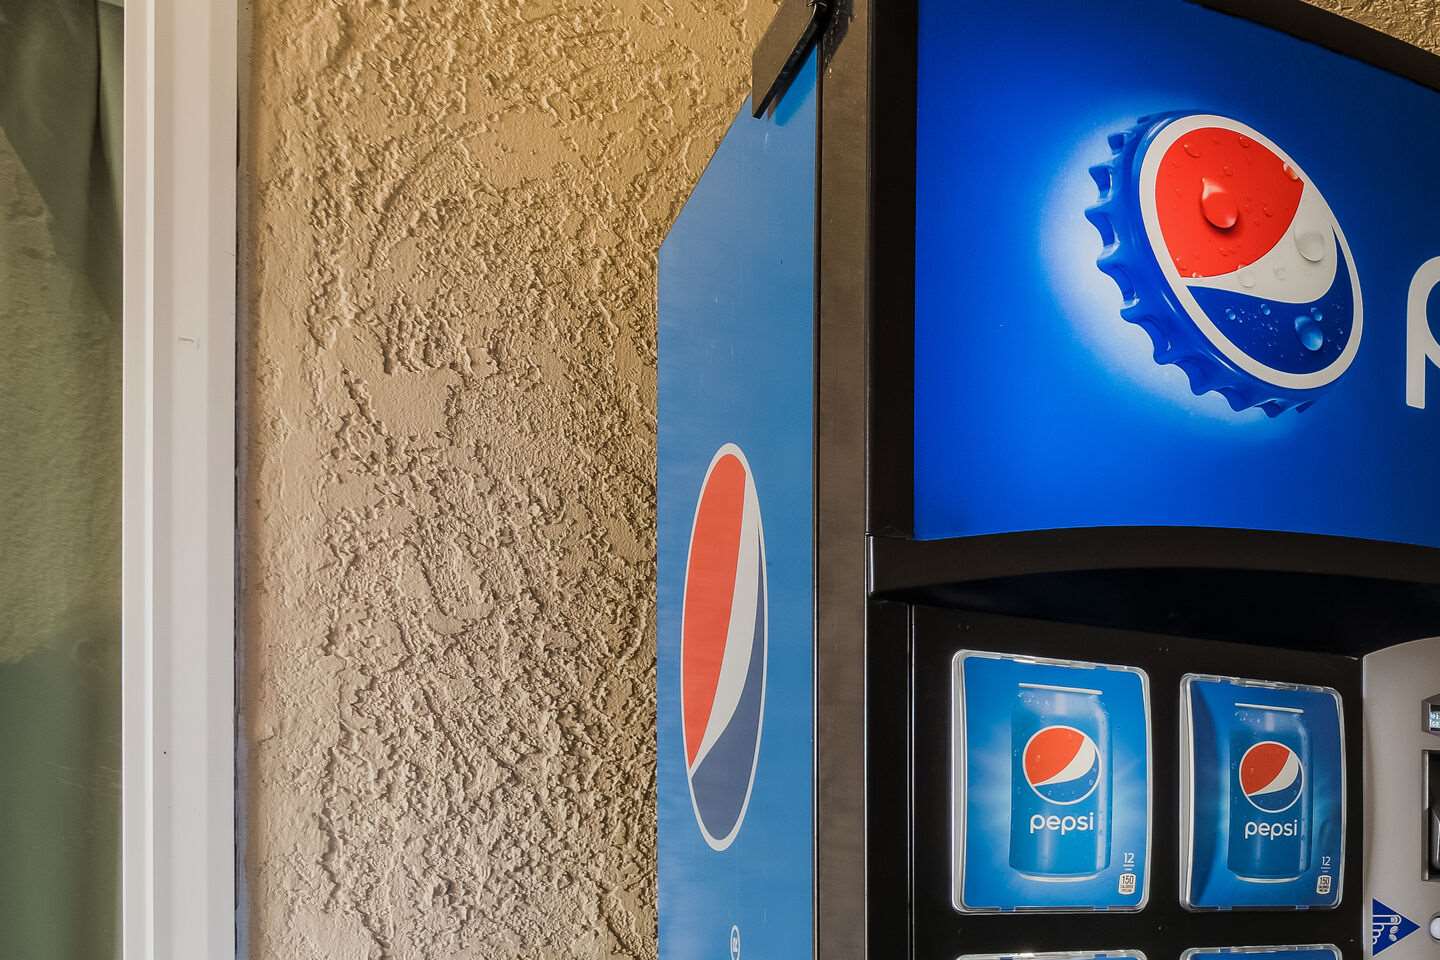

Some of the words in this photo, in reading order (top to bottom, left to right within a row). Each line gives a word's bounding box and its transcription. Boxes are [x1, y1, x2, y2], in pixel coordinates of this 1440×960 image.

[1030, 812, 1094, 835] pepsi
[1244, 819, 1298, 840] pepsi
[1123, 852, 1135, 864] 12
[1321, 856, 1331, 866] 12
[1121, 875, 1134, 884] 150
